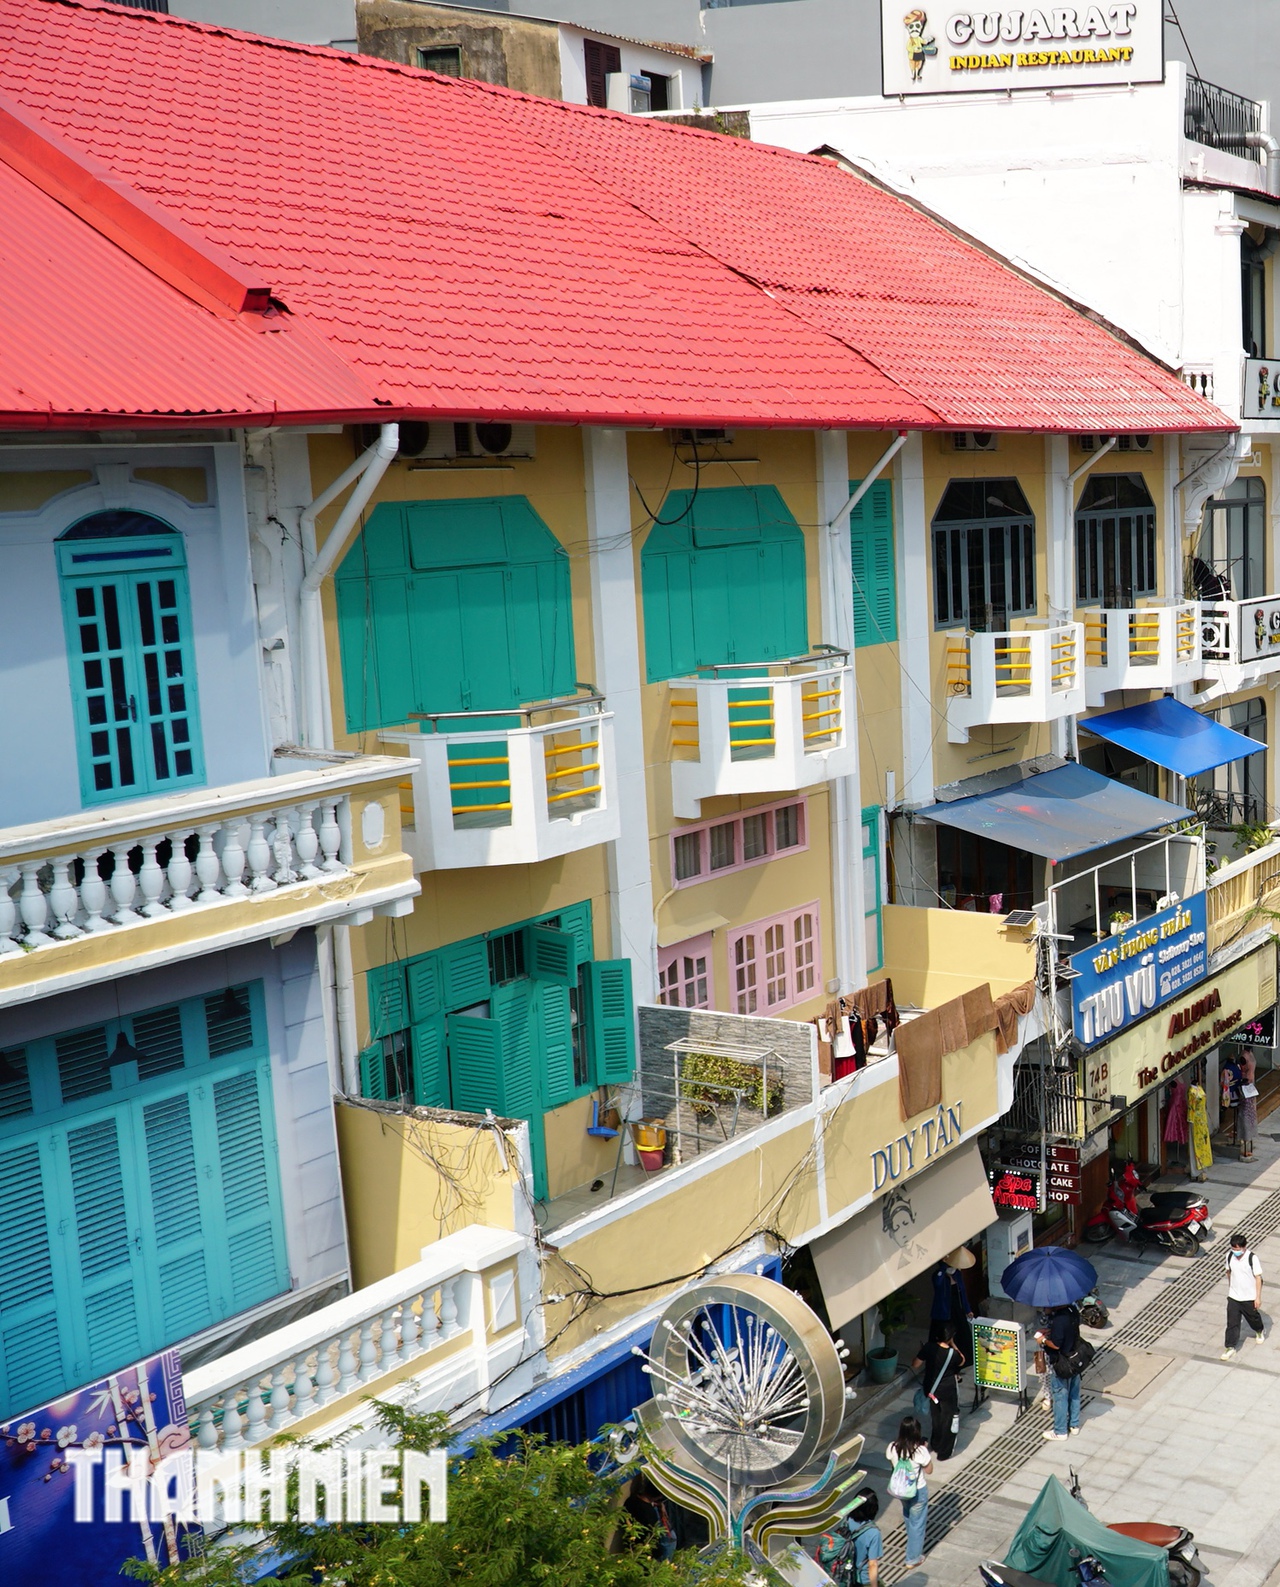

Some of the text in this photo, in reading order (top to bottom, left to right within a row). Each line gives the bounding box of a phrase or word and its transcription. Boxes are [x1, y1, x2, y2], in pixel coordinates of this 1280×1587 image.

[946, 3, 1137, 44] GUJARAT
[949, 46, 1133, 71] INDIAN RESTAURANT
[1093, 905, 1192, 974] VĂN PHÒNG PHẨM
[1079, 952, 1156, 1044] THU VŨ
[1137, 1067, 1158, 1089] The
[1161, 1030, 1211, 1074] Chocolate
[1213, 1009, 1242, 1038] House
[1254, 1035, 1271, 1044] DAY
[1090, 1062, 1108, 1088] 74B
[869, 1100, 962, 1193] DUY TÂN
[1020, 1144, 1057, 1157] COFEE
[999, 1173, 1032, 1193] Spa
[1050, 1177, 1073, 1188] CAKE
[993, 1185, 1037, 1209] Aroma
[1045, 1191, 1070, 1202] HOP
